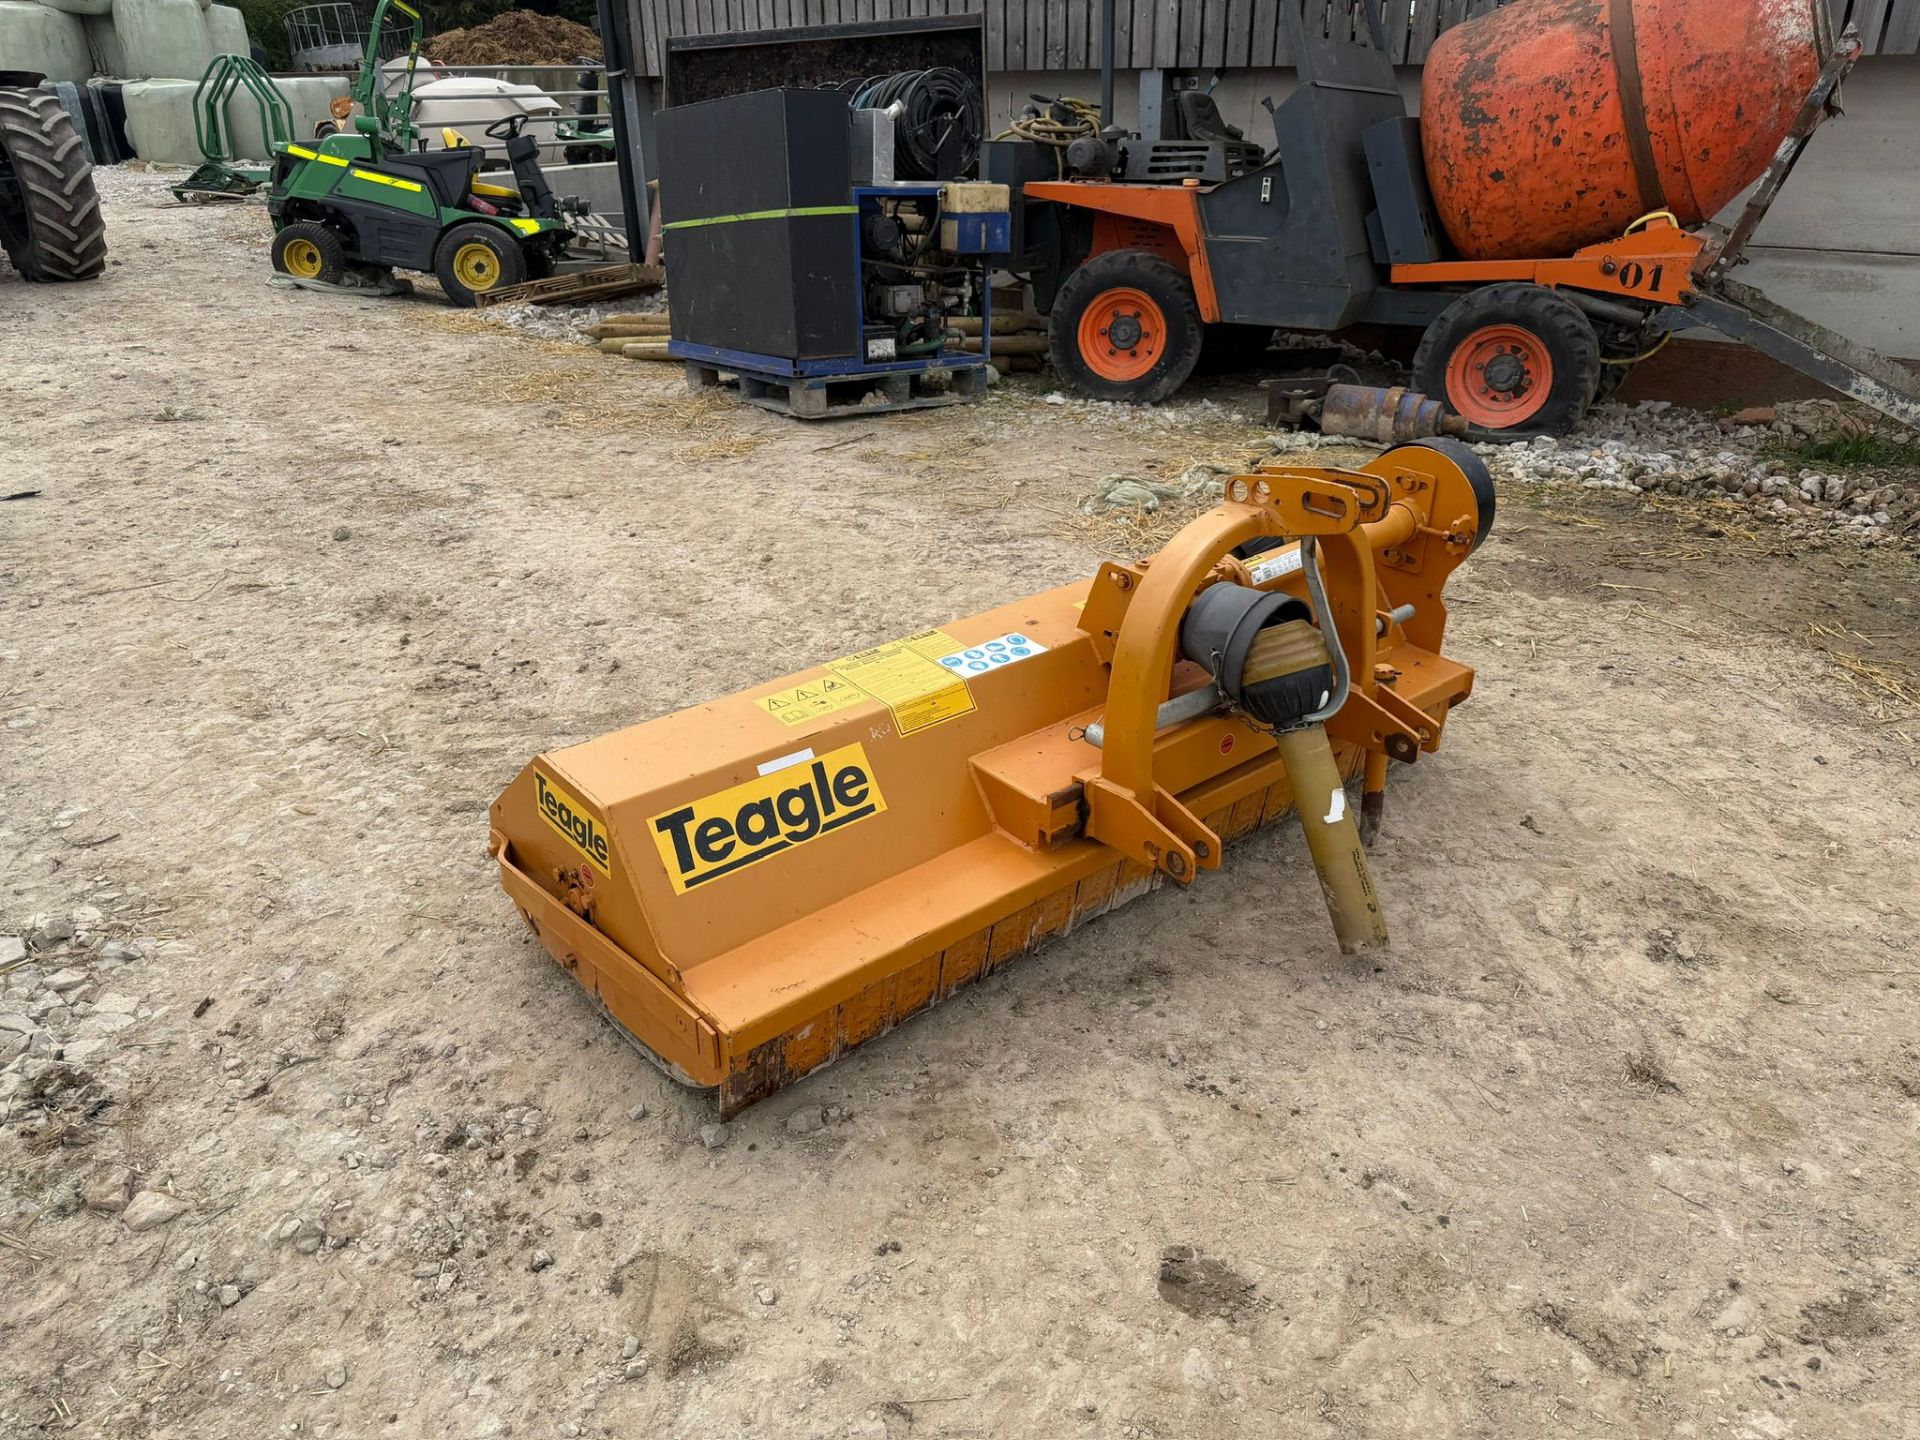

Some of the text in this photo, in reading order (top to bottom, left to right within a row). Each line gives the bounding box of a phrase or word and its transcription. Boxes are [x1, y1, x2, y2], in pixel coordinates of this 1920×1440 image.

[1619, 262, 1663, 291] 01
[535, 772, 608, 861] Teagle
[656, 760, 870, 874] Teagle
